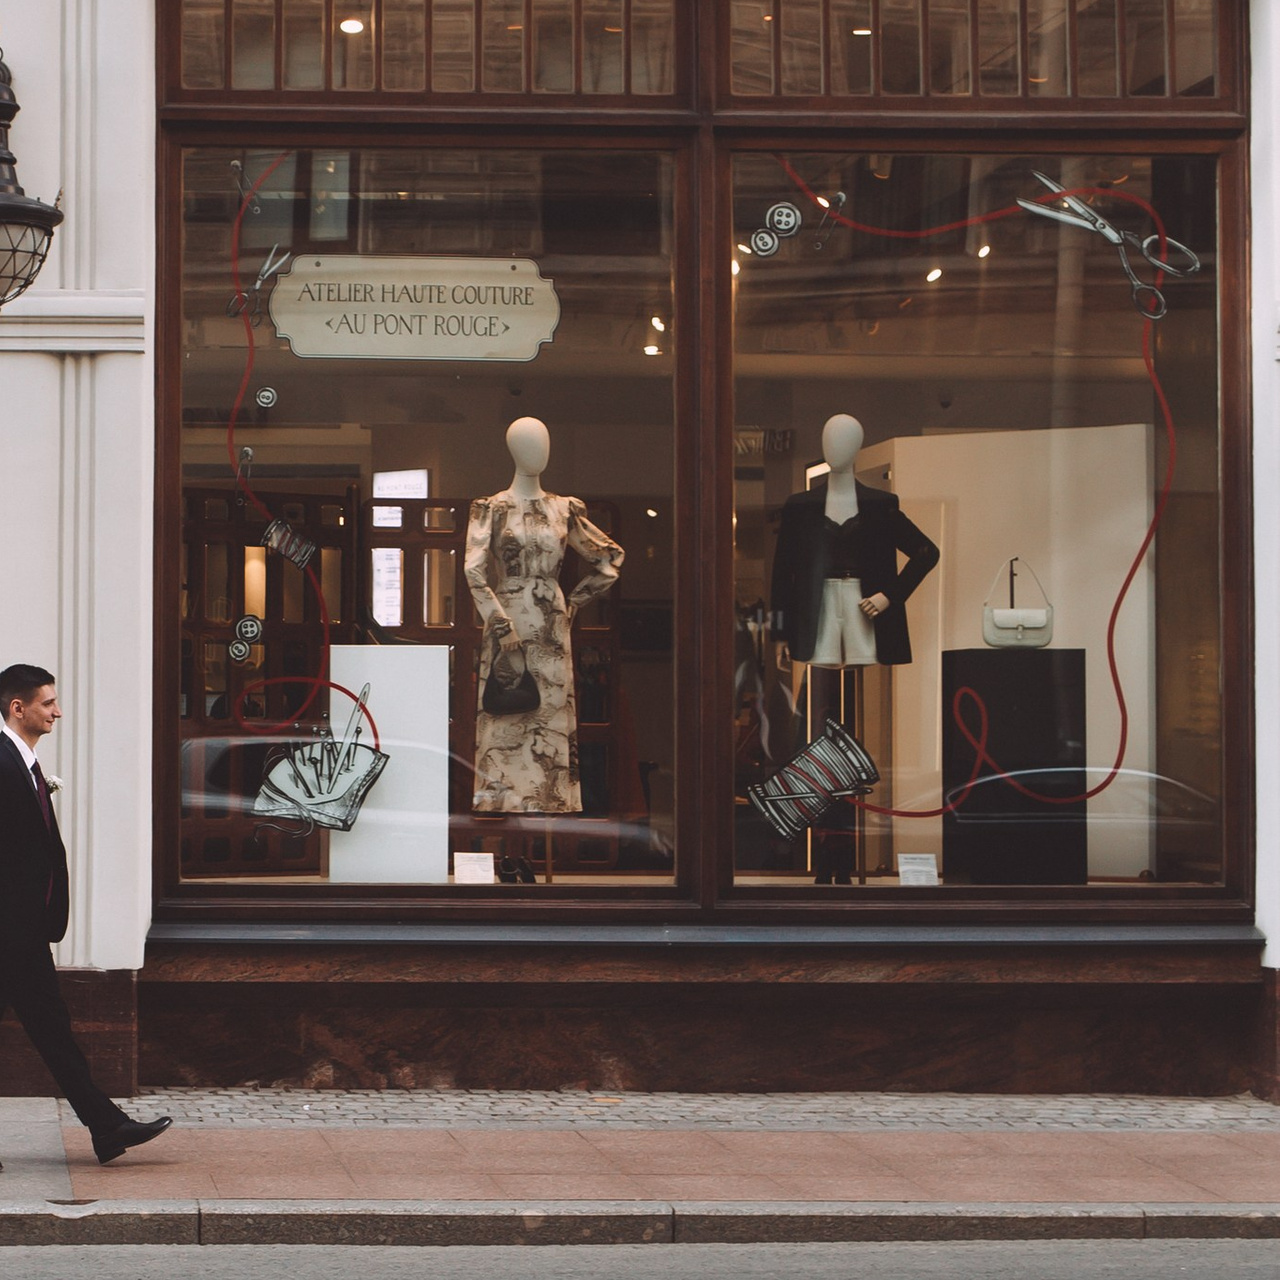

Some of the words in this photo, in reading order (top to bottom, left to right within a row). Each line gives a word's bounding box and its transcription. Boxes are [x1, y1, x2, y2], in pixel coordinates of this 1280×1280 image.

[297, 283, 375, 303] ATELIER
[381, 284, 447, 304] HAUTE
[451, 285, 535, 306] COUTURE
[373, 315, 427, 336] PONT
